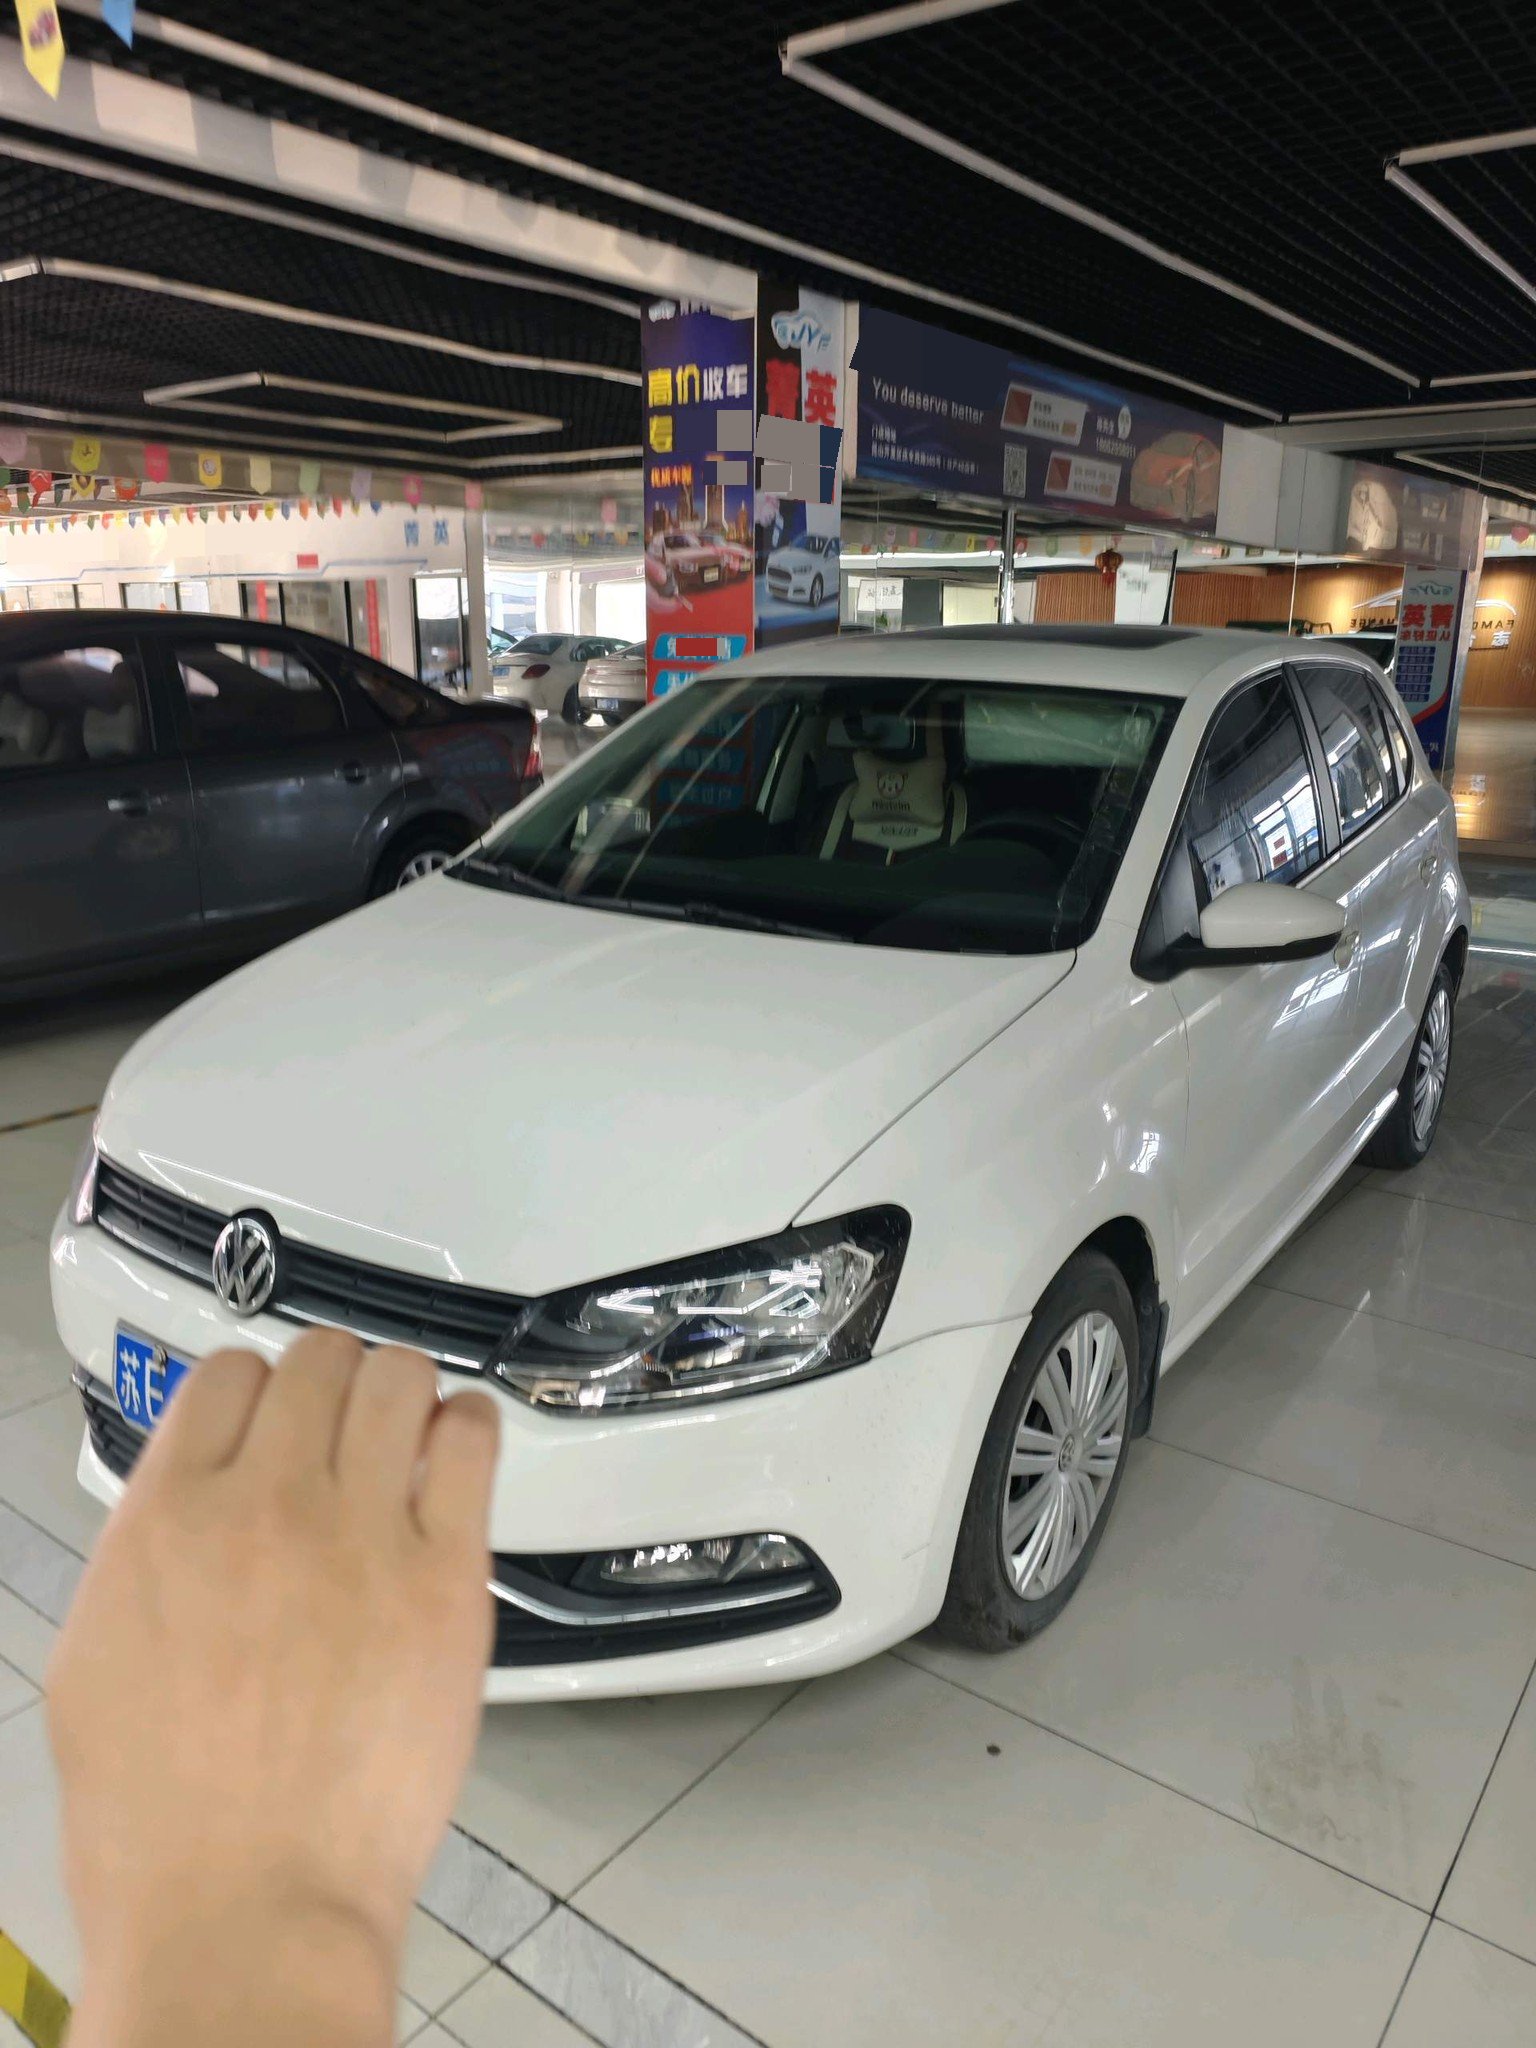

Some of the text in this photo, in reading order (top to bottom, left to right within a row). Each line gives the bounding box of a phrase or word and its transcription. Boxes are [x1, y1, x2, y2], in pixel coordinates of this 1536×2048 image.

[873, 376, 984, 424] You deserve better
